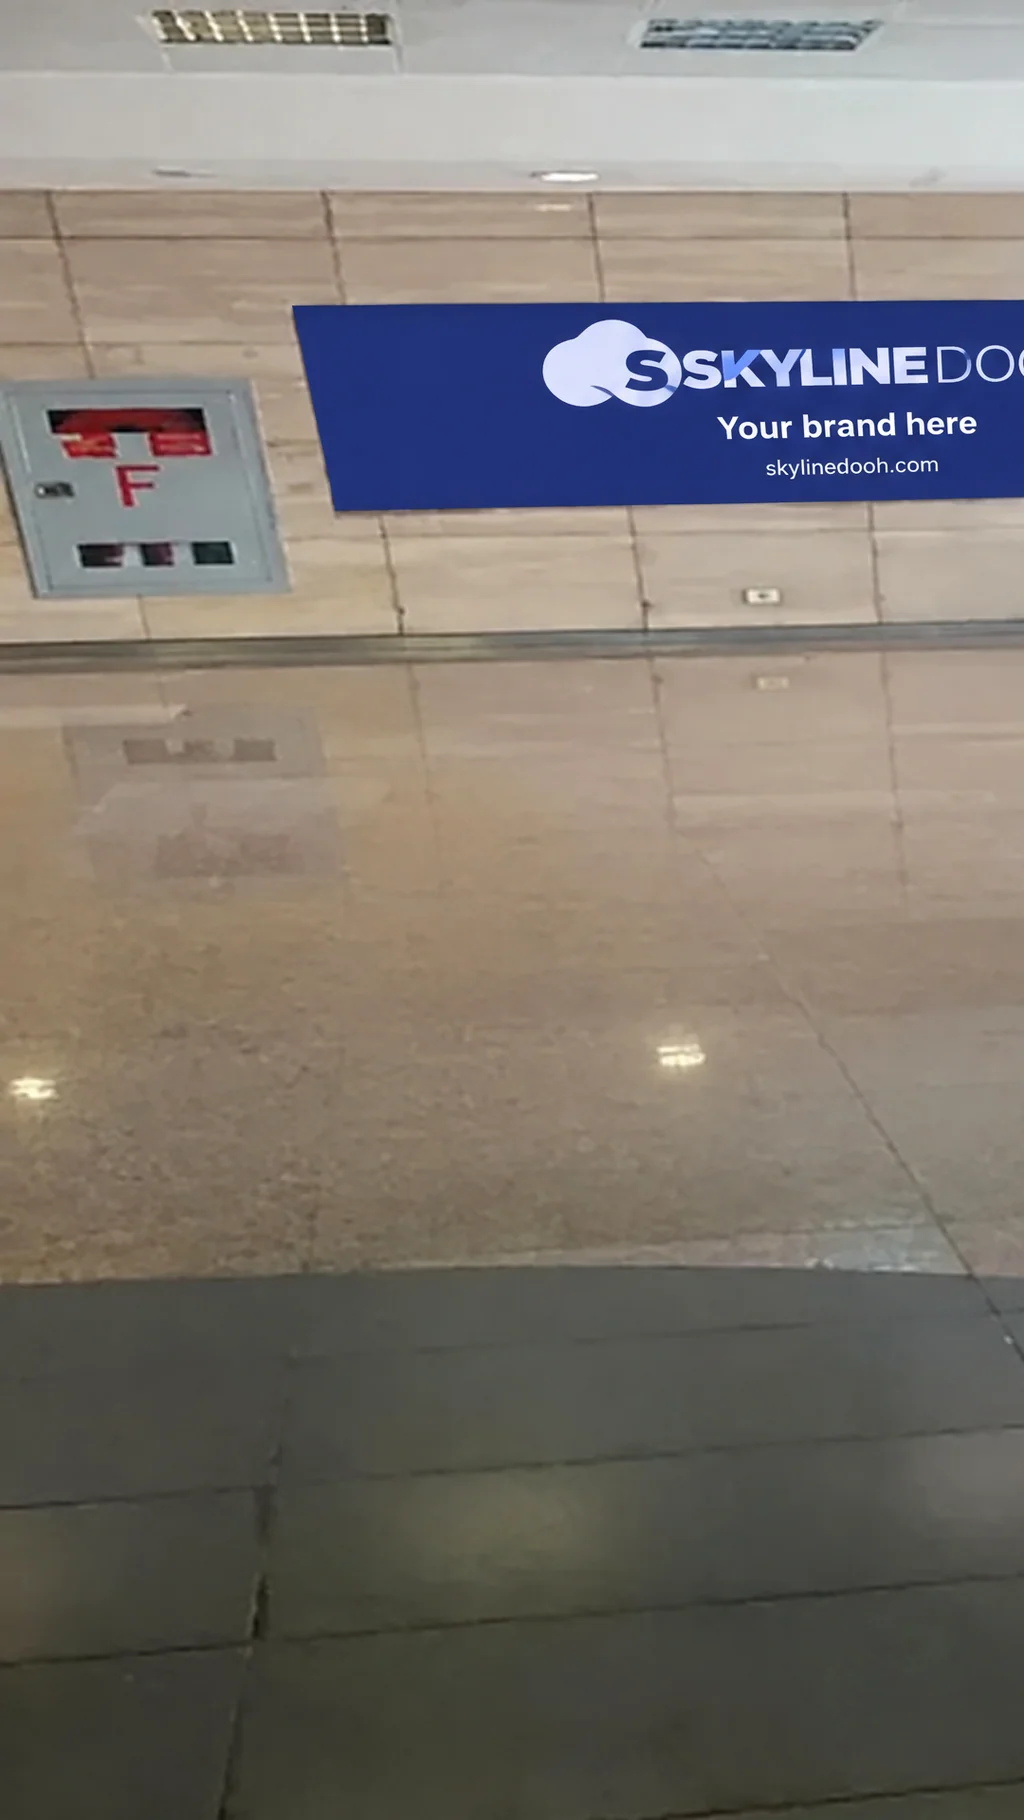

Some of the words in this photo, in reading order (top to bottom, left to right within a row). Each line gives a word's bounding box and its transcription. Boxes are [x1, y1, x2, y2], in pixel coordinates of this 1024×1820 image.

[717, 414, 793, 440] Your
[803, 412, 897, 438] brand
[906, 411, 978, 435] here
[766, 457, 939, 480] skylinedooh.com
[115, 464, 160, 507] F
